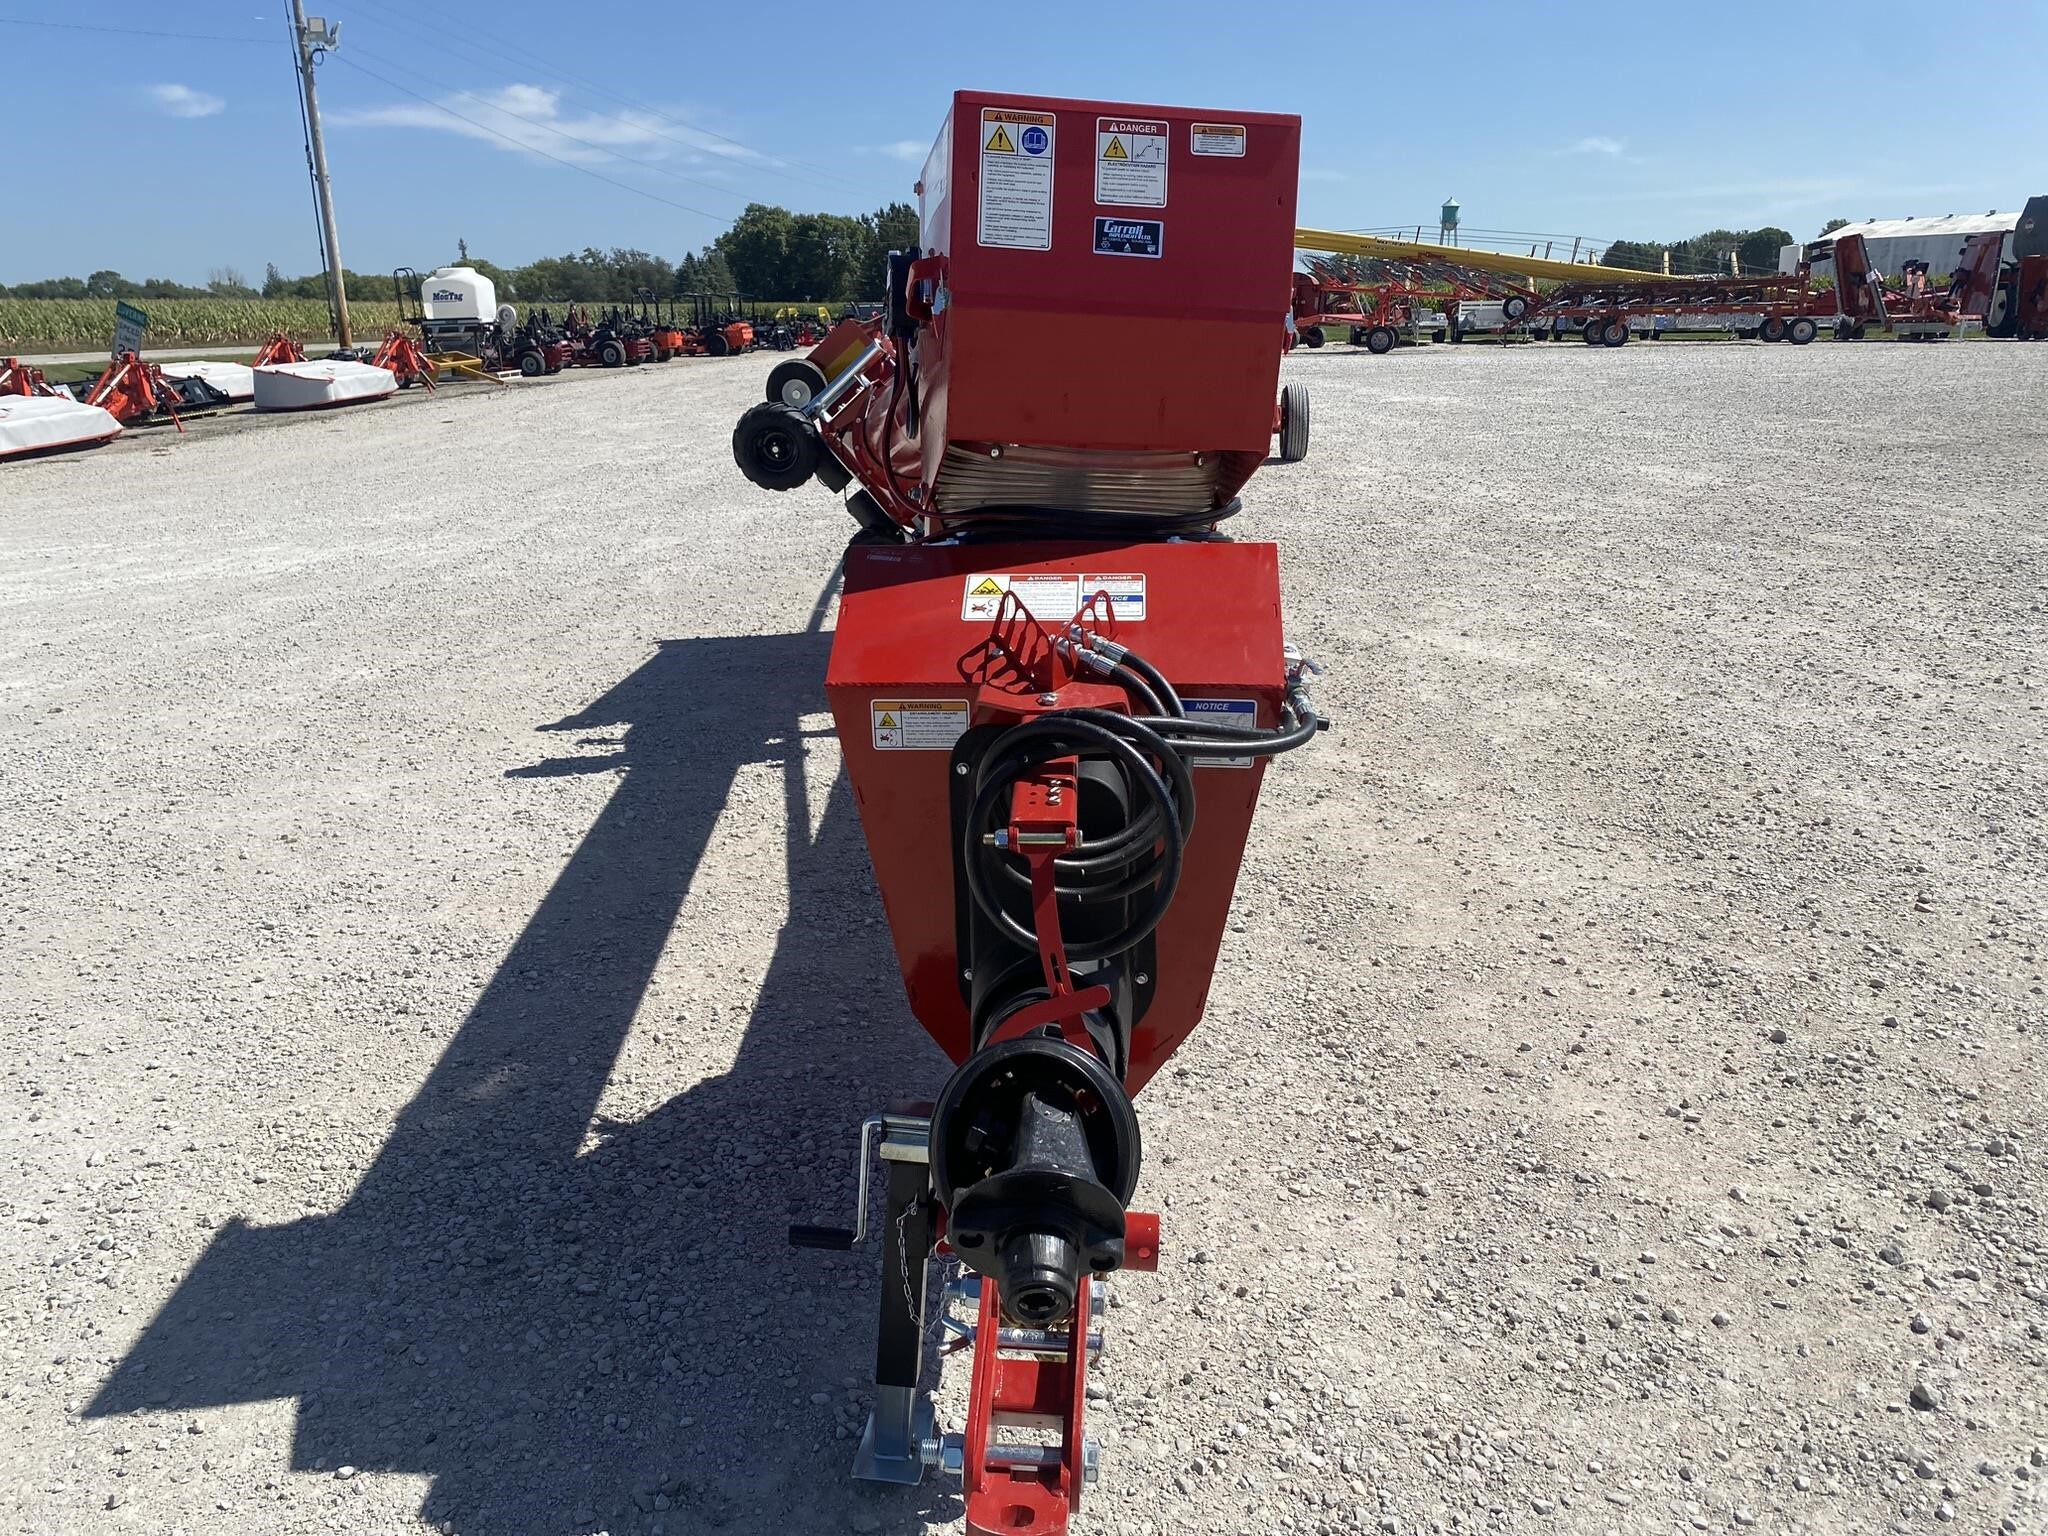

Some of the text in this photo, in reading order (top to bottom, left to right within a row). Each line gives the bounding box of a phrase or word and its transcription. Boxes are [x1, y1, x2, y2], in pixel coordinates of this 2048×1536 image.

[1004, 113, 1044, 123] WARNING
[1119, 123, 1157, 133] DANGER
[1103, 220, 1144, 239] Carroll
[119, 320, 140, 337] SPEED
[1195, 702, 1230, 711] NOTICE
